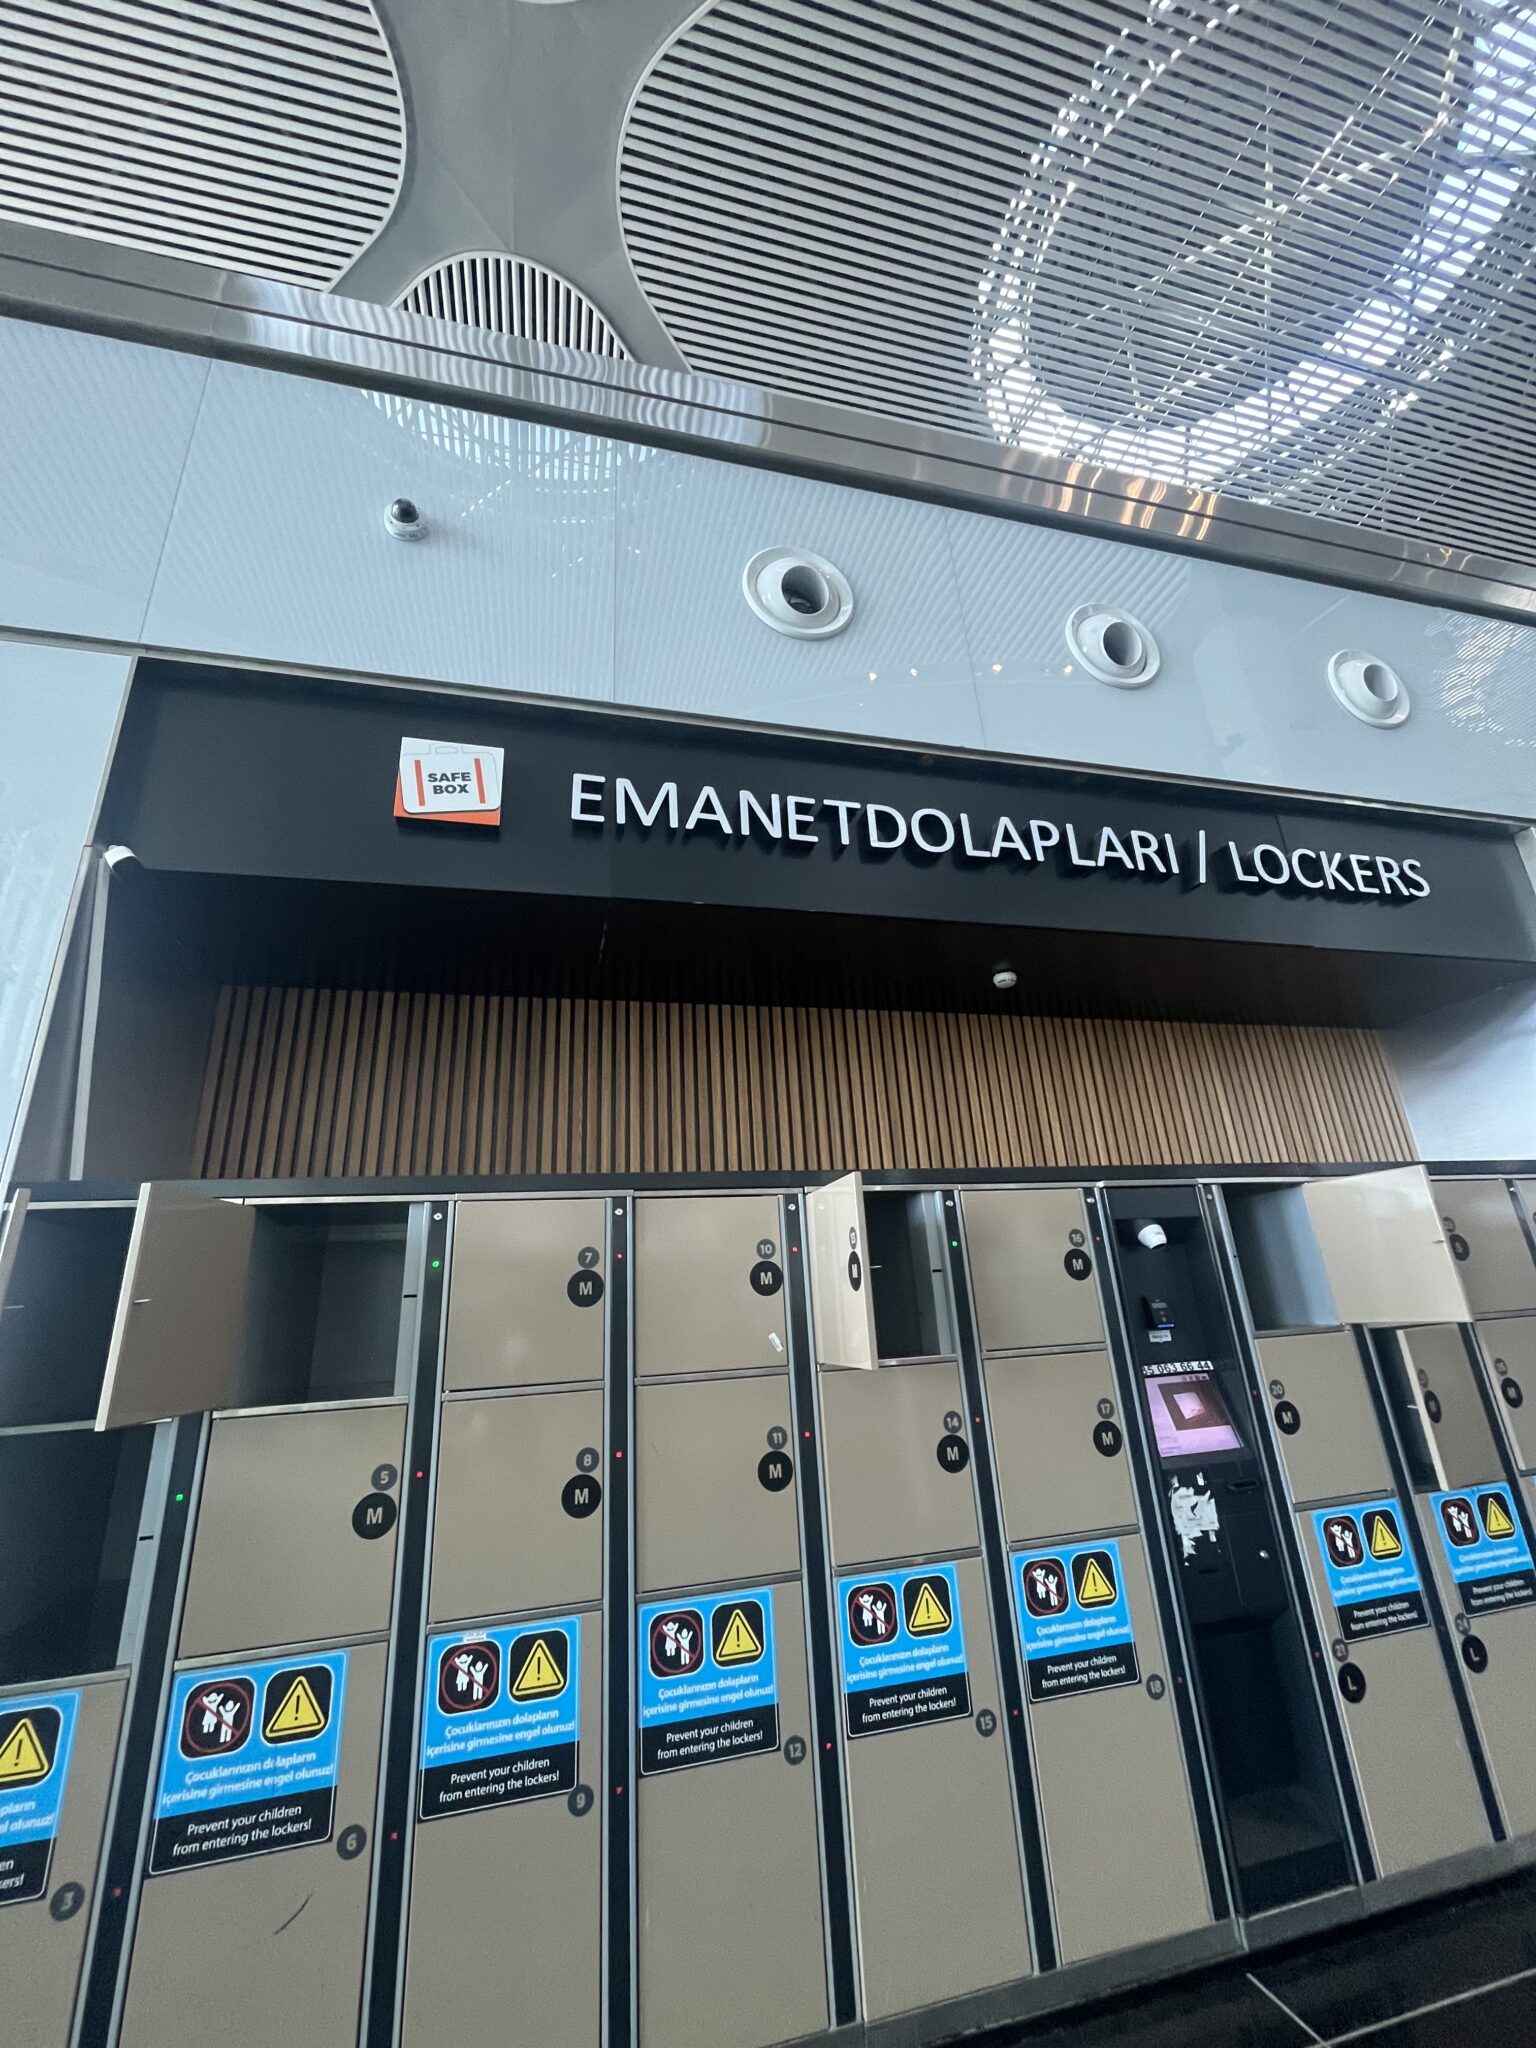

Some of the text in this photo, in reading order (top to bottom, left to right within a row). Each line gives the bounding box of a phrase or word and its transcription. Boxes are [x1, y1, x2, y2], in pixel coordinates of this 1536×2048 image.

[427, 772, 472, 783] SAFE
[432, 784, 469, 795] BOX
[1227, 840, 1432, 898] LOCKERS
[1071, 1233, 1083, 1243] 16
[760, 1244, 773, 1255] 10
[585, 1253, 593, 1263] 7
[1072, 1258, 1085, 1271] M
[760, 1271, 773, 1286] M
[579, 1281, 593, 1296] M
[1157, 1363, 1178, 1374] 063
[1180, 1361, 1195, 1372] 66
[1198, 1360, 1210, 1370] 44
[1271, 1384, 1284, 1395] 20
[1100, 1403, 1111, 1414] 17
[947, 1417, 959, 1428] 14
[772, 1432, 783, 1444] 11
[1102, 1431, 1115, 1446] M
[583, 1454, 592, 1466] 8
[946, 1447, 960, 1461] M
[379, 1471, 389, 1484] 5
[769, 1463, 783, 1480] M
[574, 1487, 589, 1505] M
[366, 1506, 383, 1525] M
[1470, 1647, 1480, 1661] L
[1047, 1654, 1117, 1674] Prevent your children
[717, 1673, 759, 1690] dolapların
[1042, 1665, 1126, 1689] from entering the lockers!
[1346, 1675, 1357, 1691] L
[1149, 1680, 1161, 1694] 18
[720, 1689, 744, 1702] engel
[869, 1685, 948, 1708] Prevent your children
[862, 1697, 957, 1723] from entering the lockers!
[512, 1708, 560, 1728] dolapların
[980, 1716, 993, 1730] 15
[666, 1718, 754, 1743] Prevent your children
[467, 1730, 514, 1751] girmesine
[515, 1726, 541, 1741] engel
[657, 1730, 763, 1760] from entering the lockers!
[789, 1742, 803, 1758] 12
[450, 1757, 550, 1784] Prevent your children
[208, 1778, 263, 1800] girmesine
[264, 1773, 294, 1789] engel
[295, 1763, 334, 1780] olunuz!
[439, 1770, 560, 1803] from entering the lockers!
[576, 1793, 585, 1808] 9
[187, 1805, 302, 1836] Prevent your children
[172, 1818, 312, 1857] from entering the lockers!
[346, 1833, 357, 1850] 6
